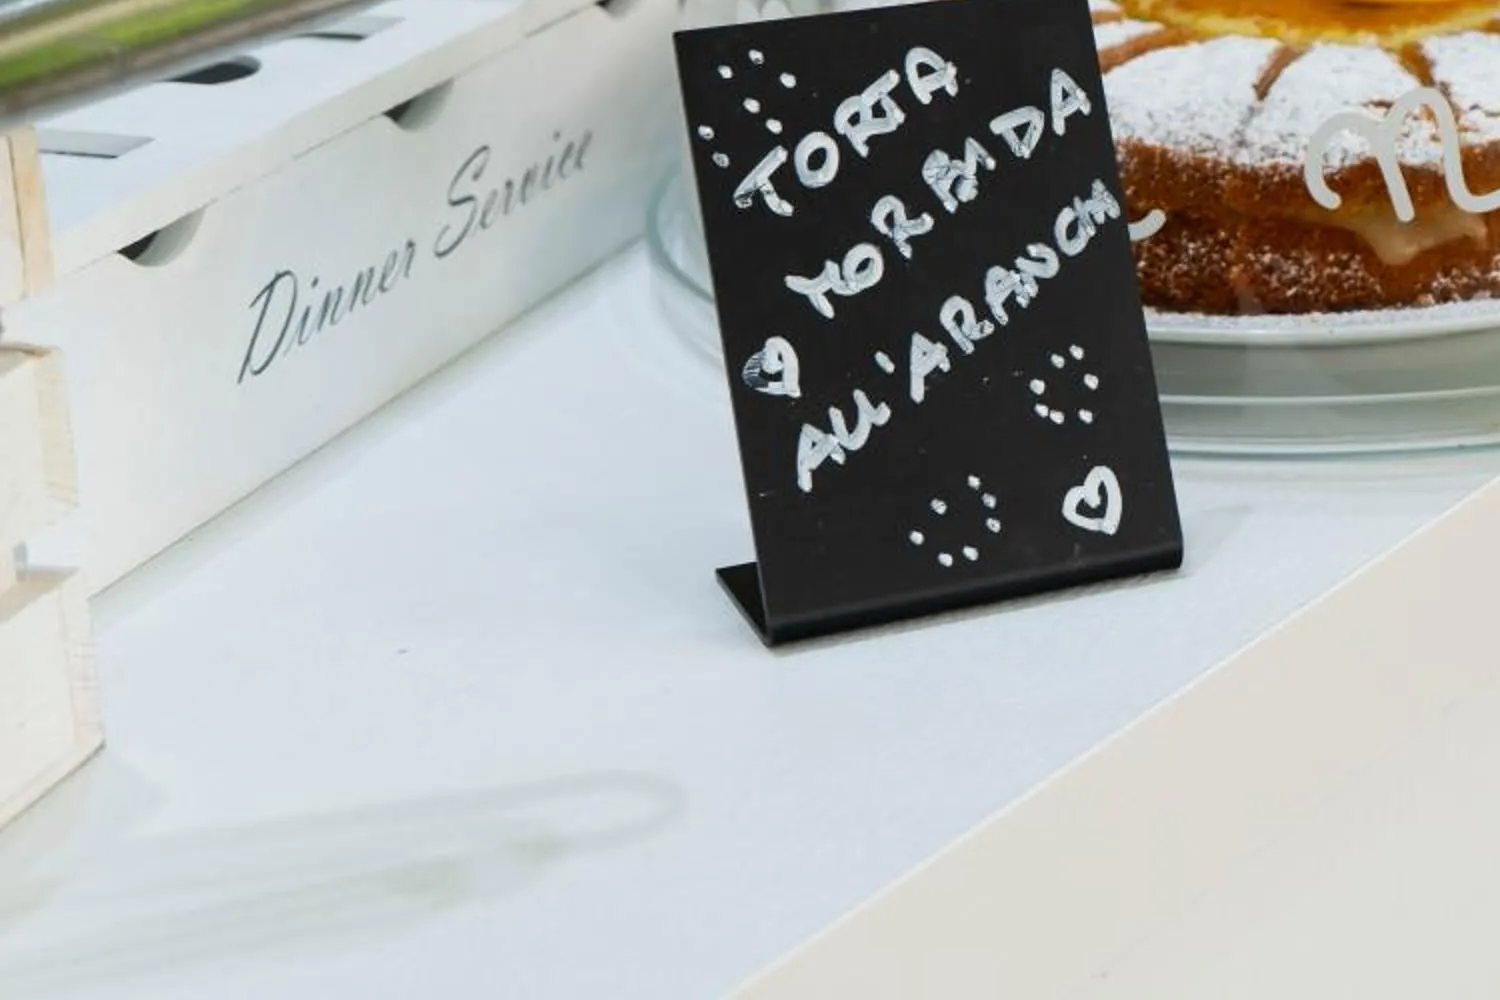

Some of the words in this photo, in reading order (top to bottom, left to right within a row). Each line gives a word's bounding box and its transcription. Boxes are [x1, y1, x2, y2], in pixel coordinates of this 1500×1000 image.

[733, 46, 959, 218] TORTA
[236, 240, 417, 384] Dinner
[433, 128, 593, 259] Service
